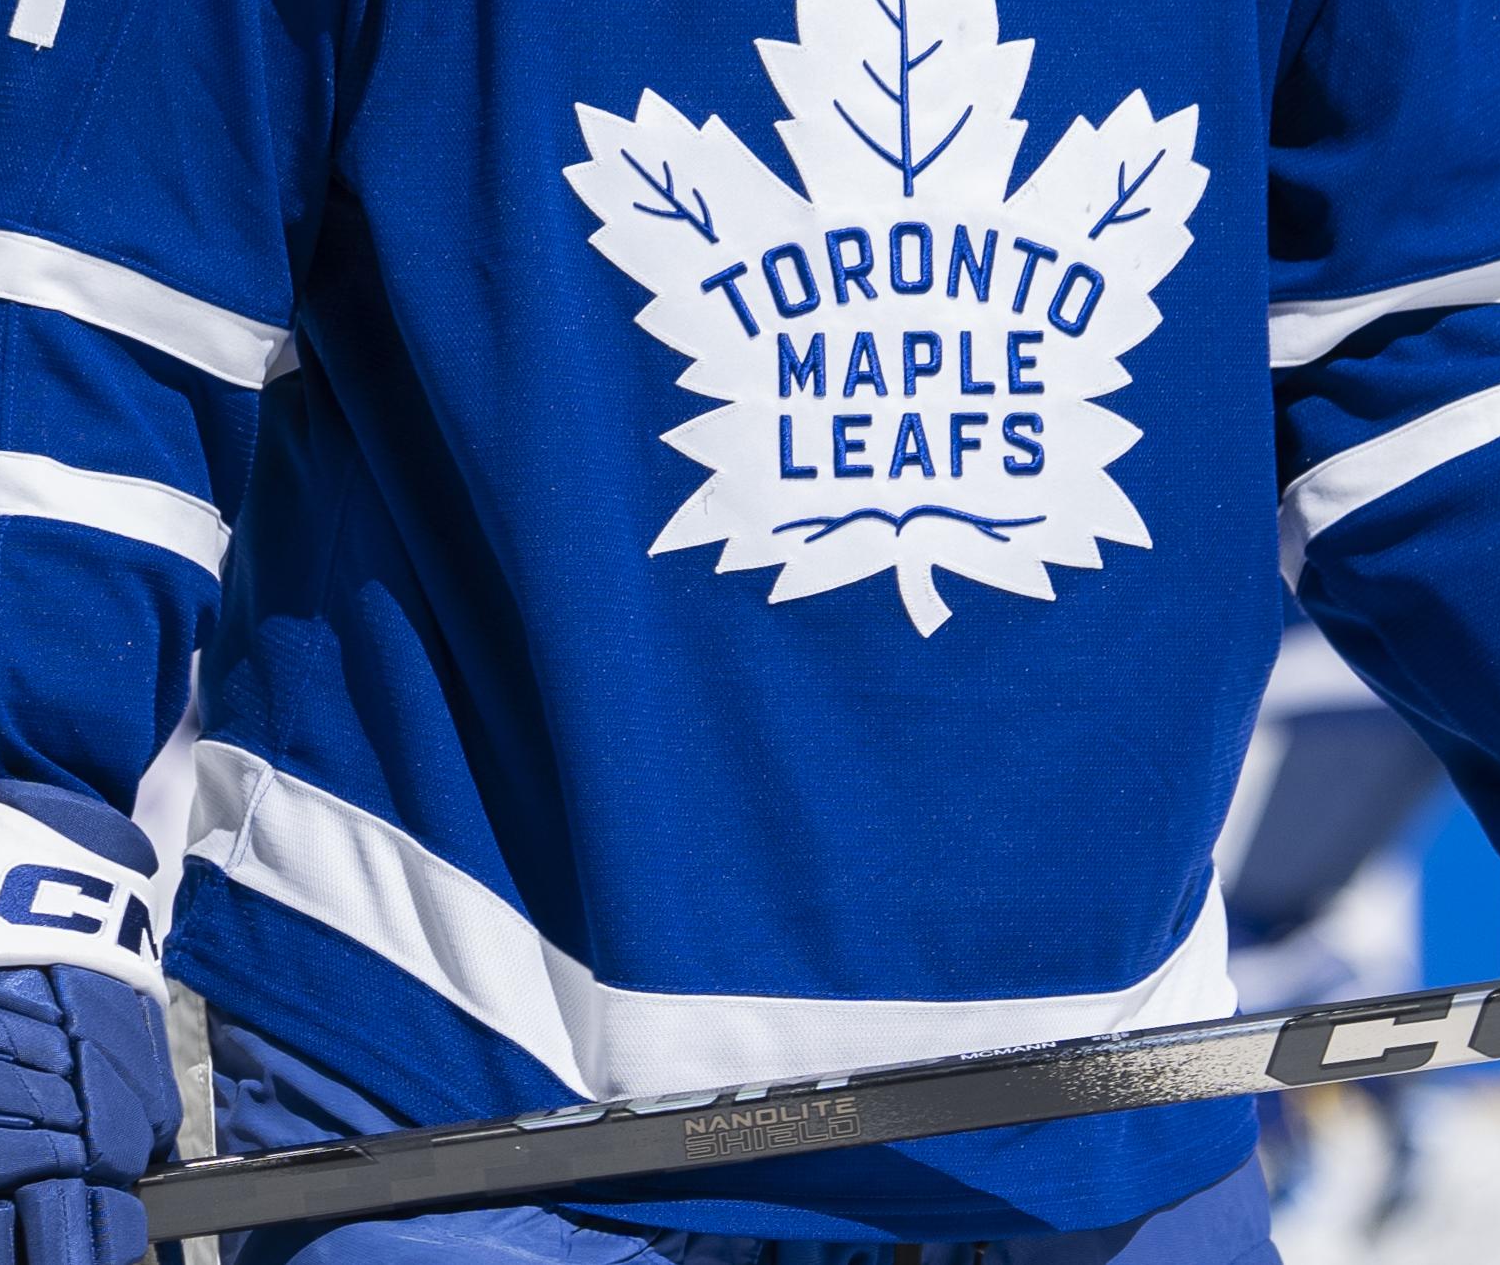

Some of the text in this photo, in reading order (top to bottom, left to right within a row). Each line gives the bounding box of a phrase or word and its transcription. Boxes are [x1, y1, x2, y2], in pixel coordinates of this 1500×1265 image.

[701, 221, 1105, 337] TORONTO
[777, 329, 1046, 397] MAPLE
[778, 412, 1046, 480] LEAFS
[684, 1096, 857, 1136] NANOLITE
[685, 1112, 861, 1160] SHIELD
